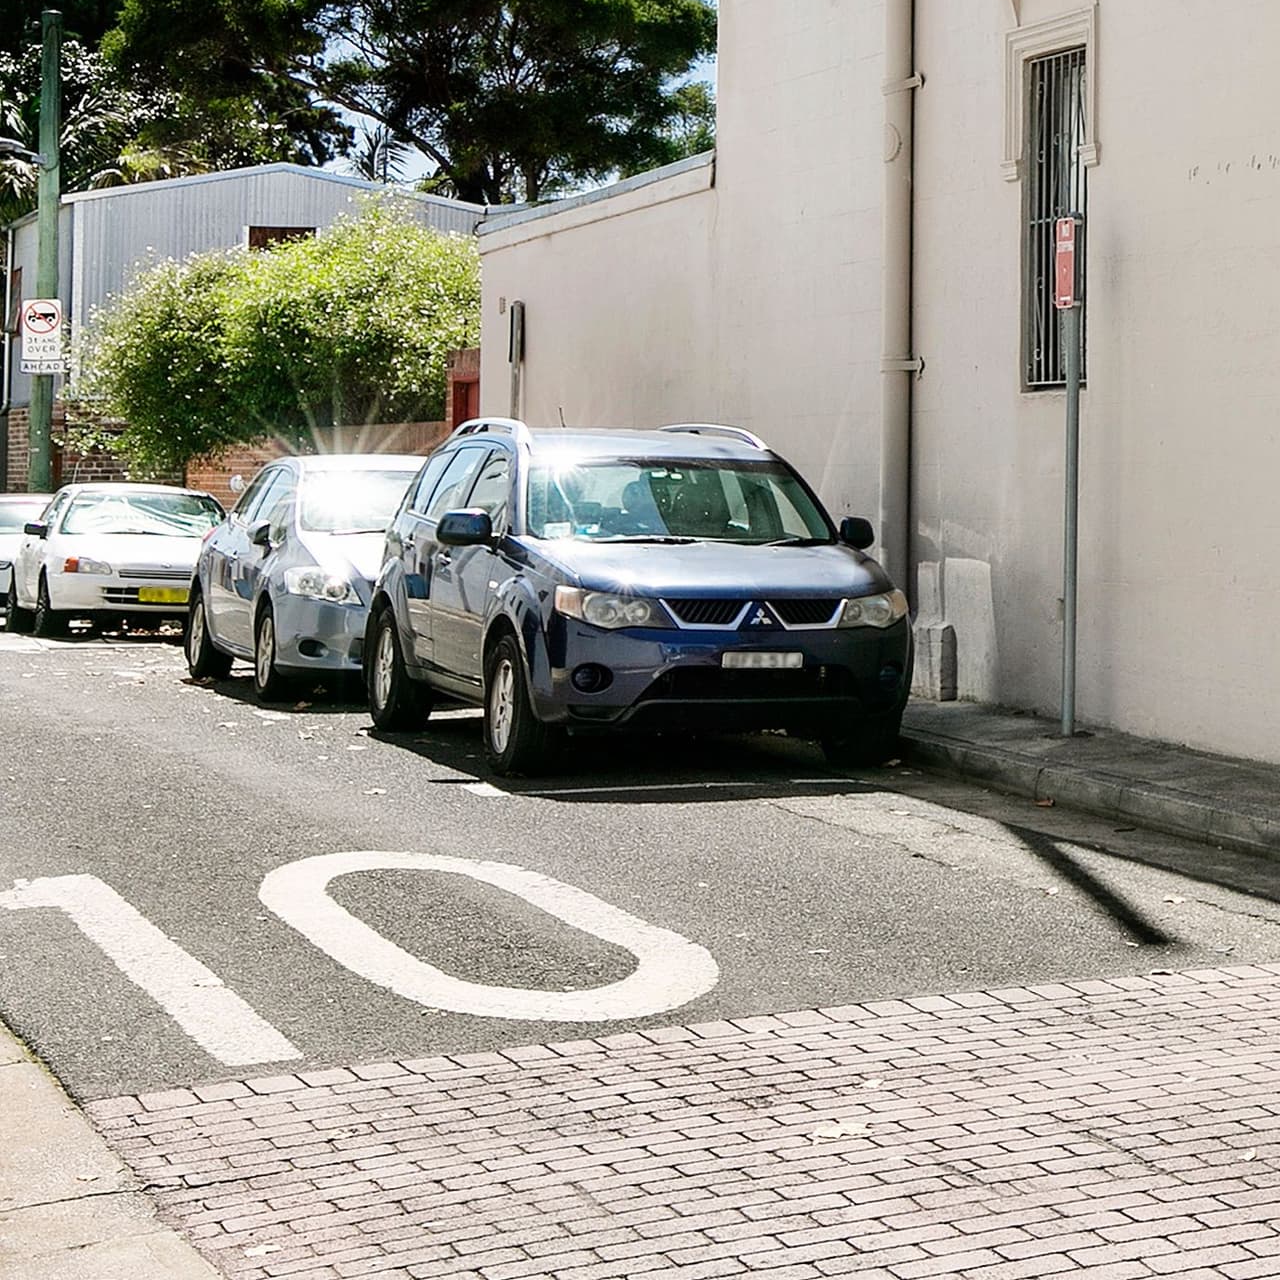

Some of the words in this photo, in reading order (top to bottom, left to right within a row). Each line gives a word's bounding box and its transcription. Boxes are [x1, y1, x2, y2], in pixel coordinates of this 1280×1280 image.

[27, 345, 56, 353] OVER
[23, 363, 60, 371] AHEAD
[0, 850, 719, 1066] 10
